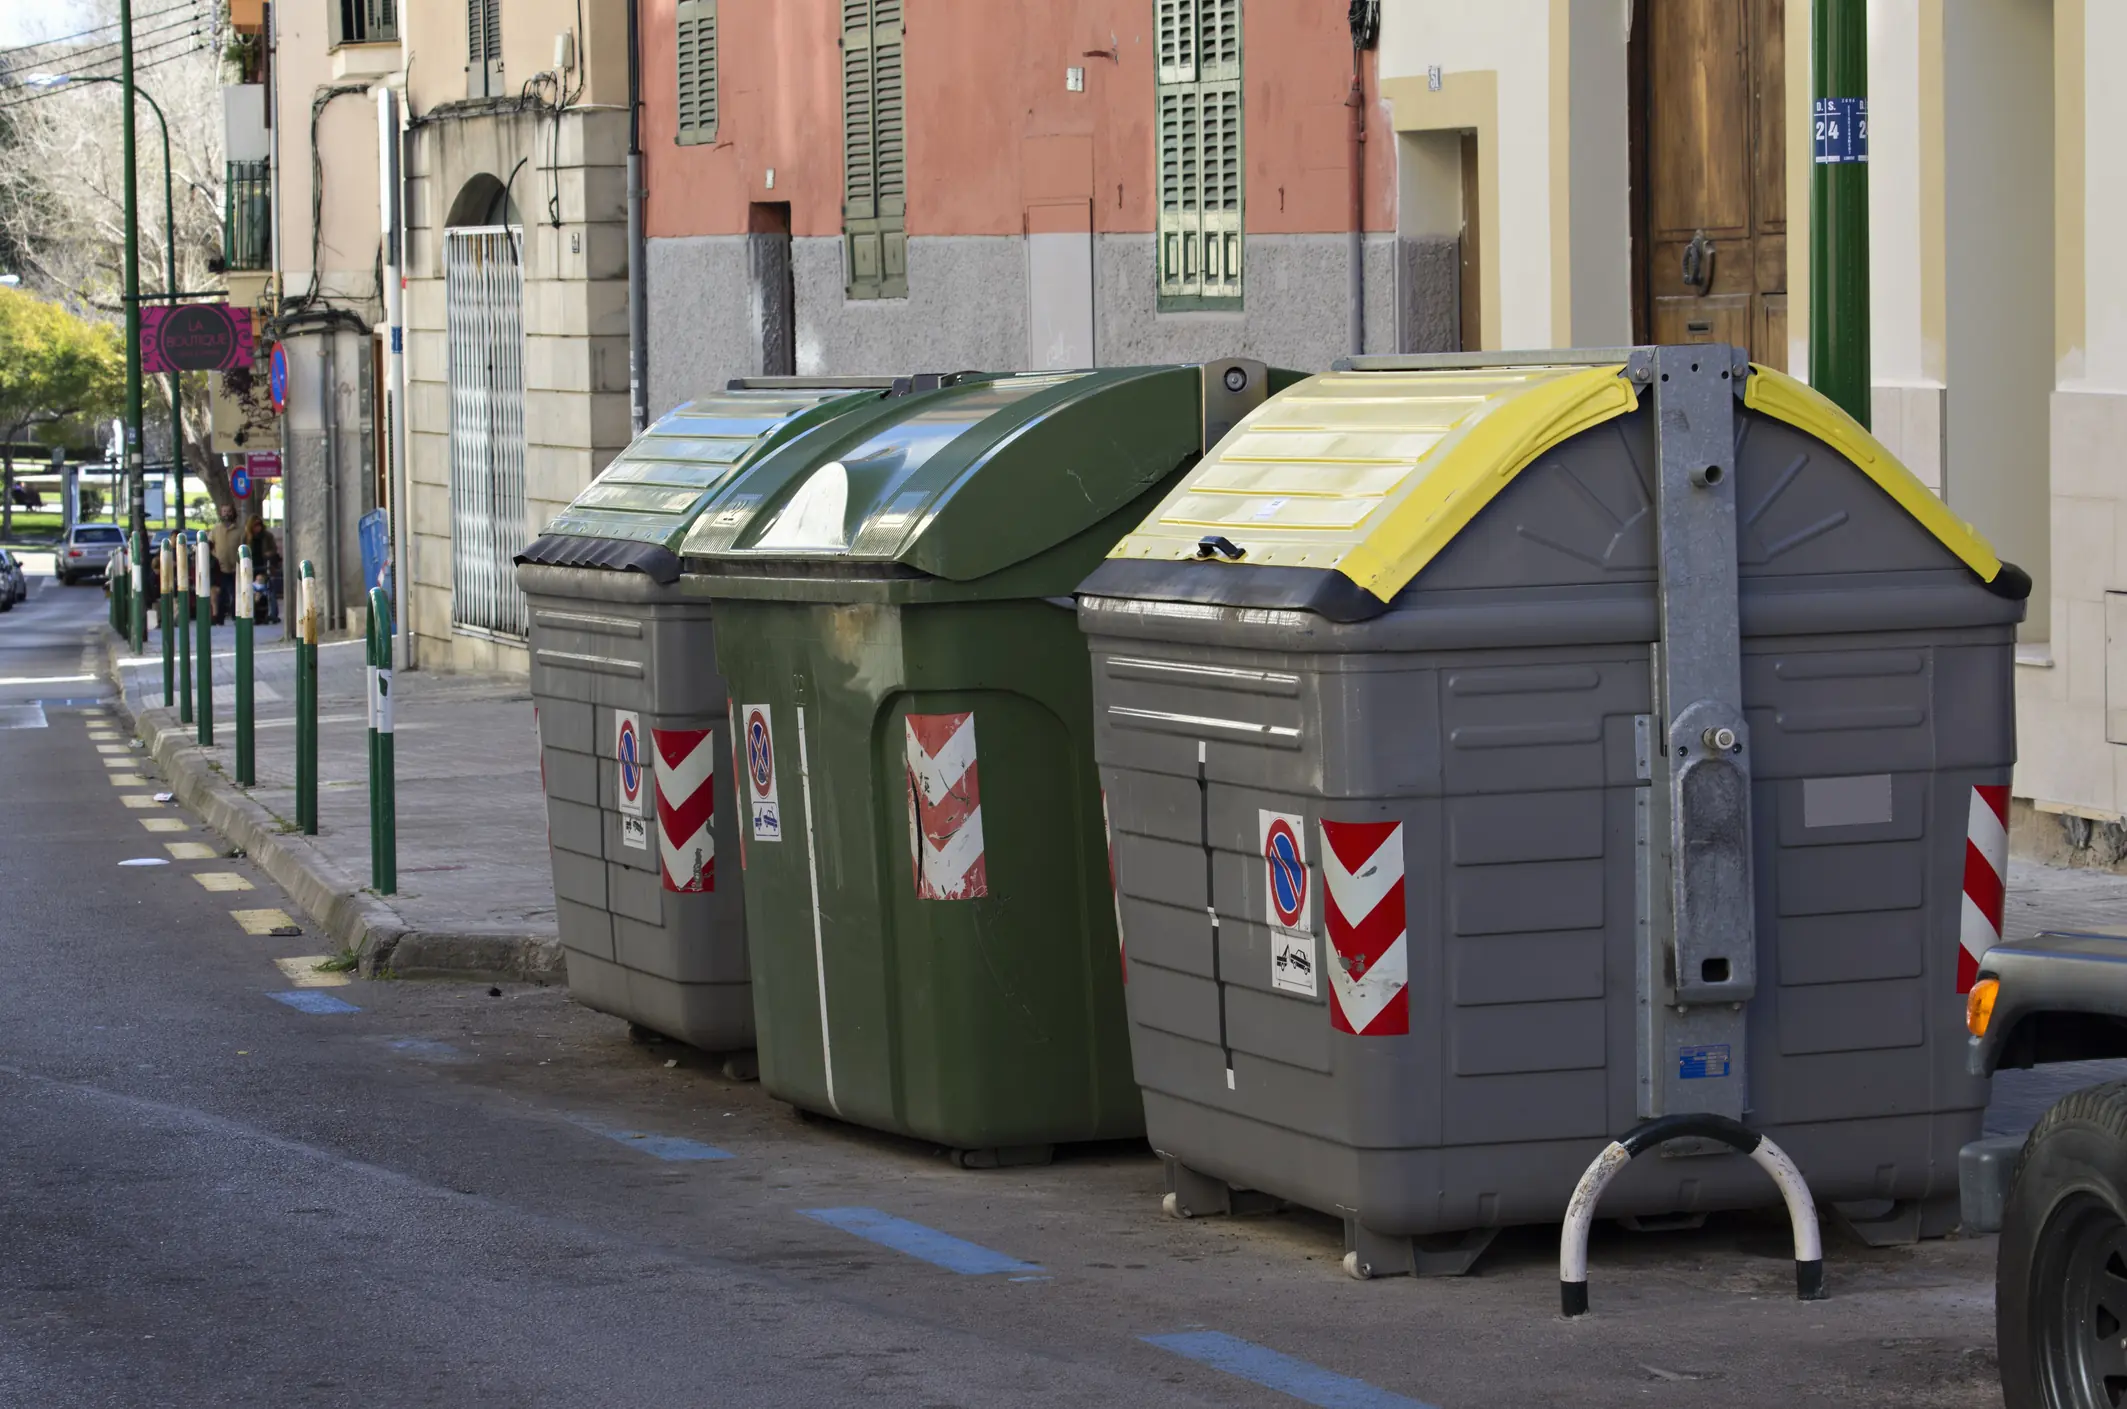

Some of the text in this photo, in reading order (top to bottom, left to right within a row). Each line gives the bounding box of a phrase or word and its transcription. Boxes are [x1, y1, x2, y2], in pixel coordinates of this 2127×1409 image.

[1828, 101, 1836, 111] S.
[188, 317, 204, 332] LA
[166, 333, 227, 347] BOUTIQUE
